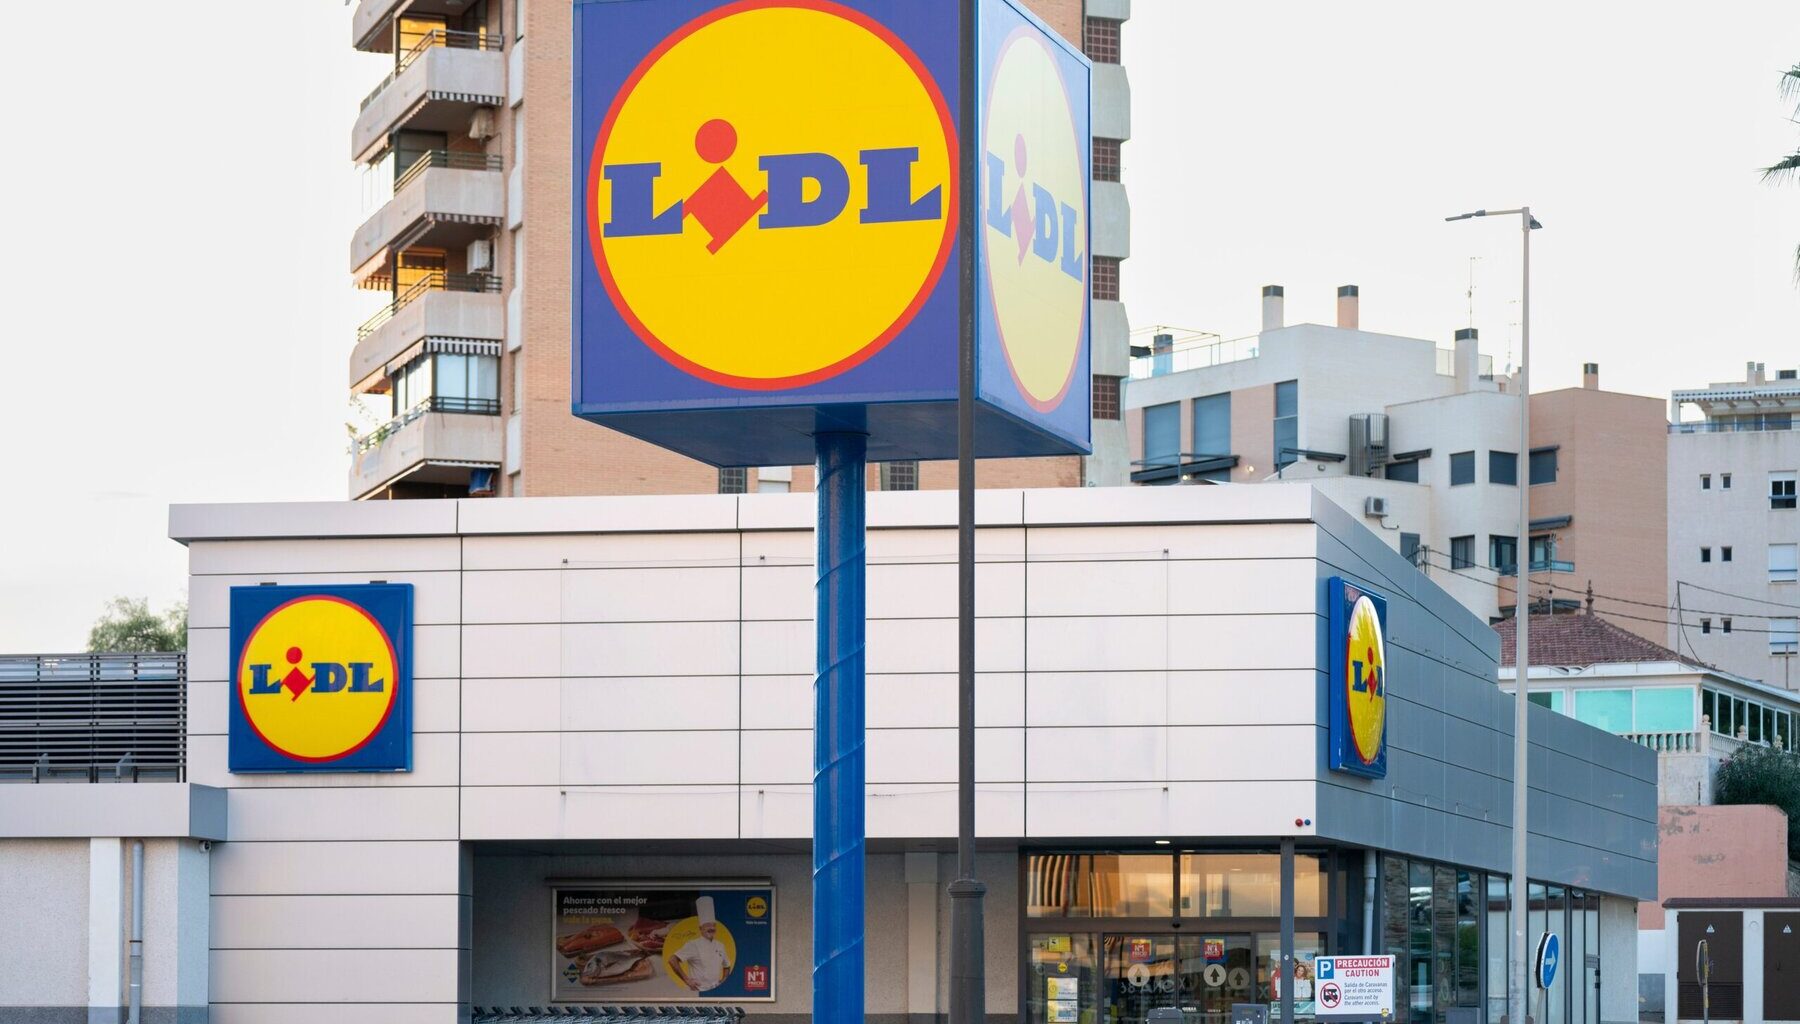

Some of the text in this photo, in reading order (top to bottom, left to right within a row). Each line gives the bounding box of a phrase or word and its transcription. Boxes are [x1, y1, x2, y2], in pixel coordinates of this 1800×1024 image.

[563, 896, 595, 905] Ahorrar
[613, 896, 622, 905] el
[623, 896, 648, 906] mejor
[563, 906, 626, 916] pescado fresco
[1337, 958, 1388, 968] PRECAUCIÓN
[1320, 961, 1331, 978] P
[1345, 969, 1380, 977] CAUTION
